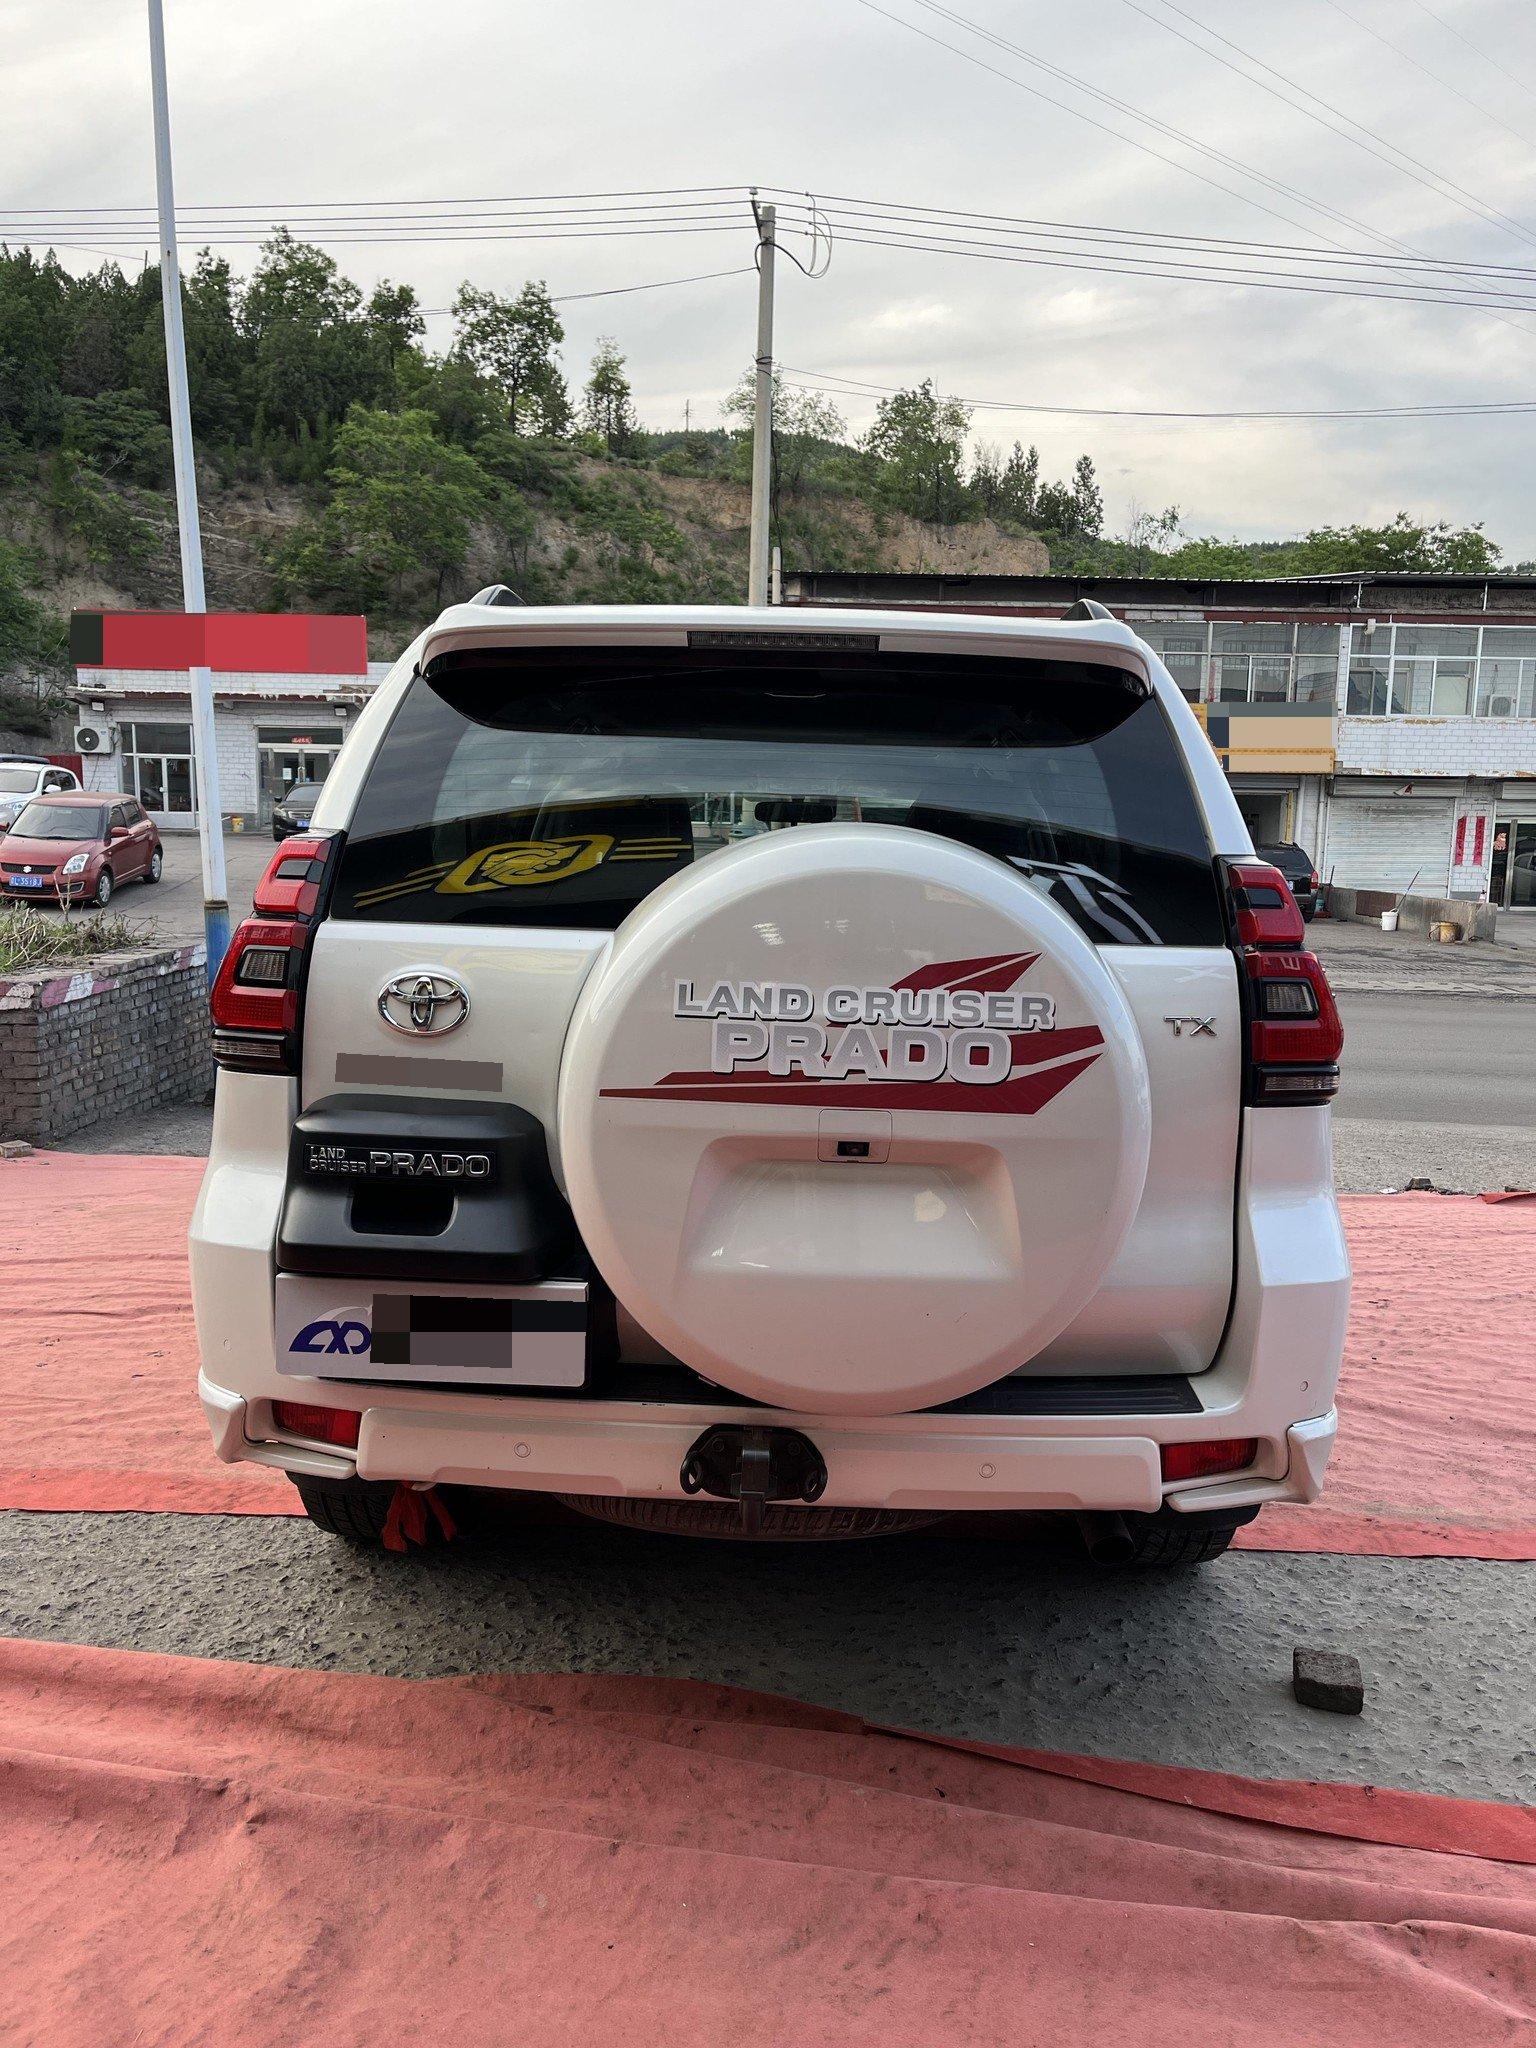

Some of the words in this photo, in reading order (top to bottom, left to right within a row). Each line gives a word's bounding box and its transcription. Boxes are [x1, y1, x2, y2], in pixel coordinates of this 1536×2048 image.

[674, 979, 814, 1020] LAND
[824, 985, 1055, 1031] CRUISER
[1164, 1016, 1217, 1036] TX
[711, 1021, 1012, 1084] PRADO
[310, 1146, 346, 1160] LAND
[369, 1151, 491, 1178] PRADO
[309, 1158, 367, 1174] CRUISER
